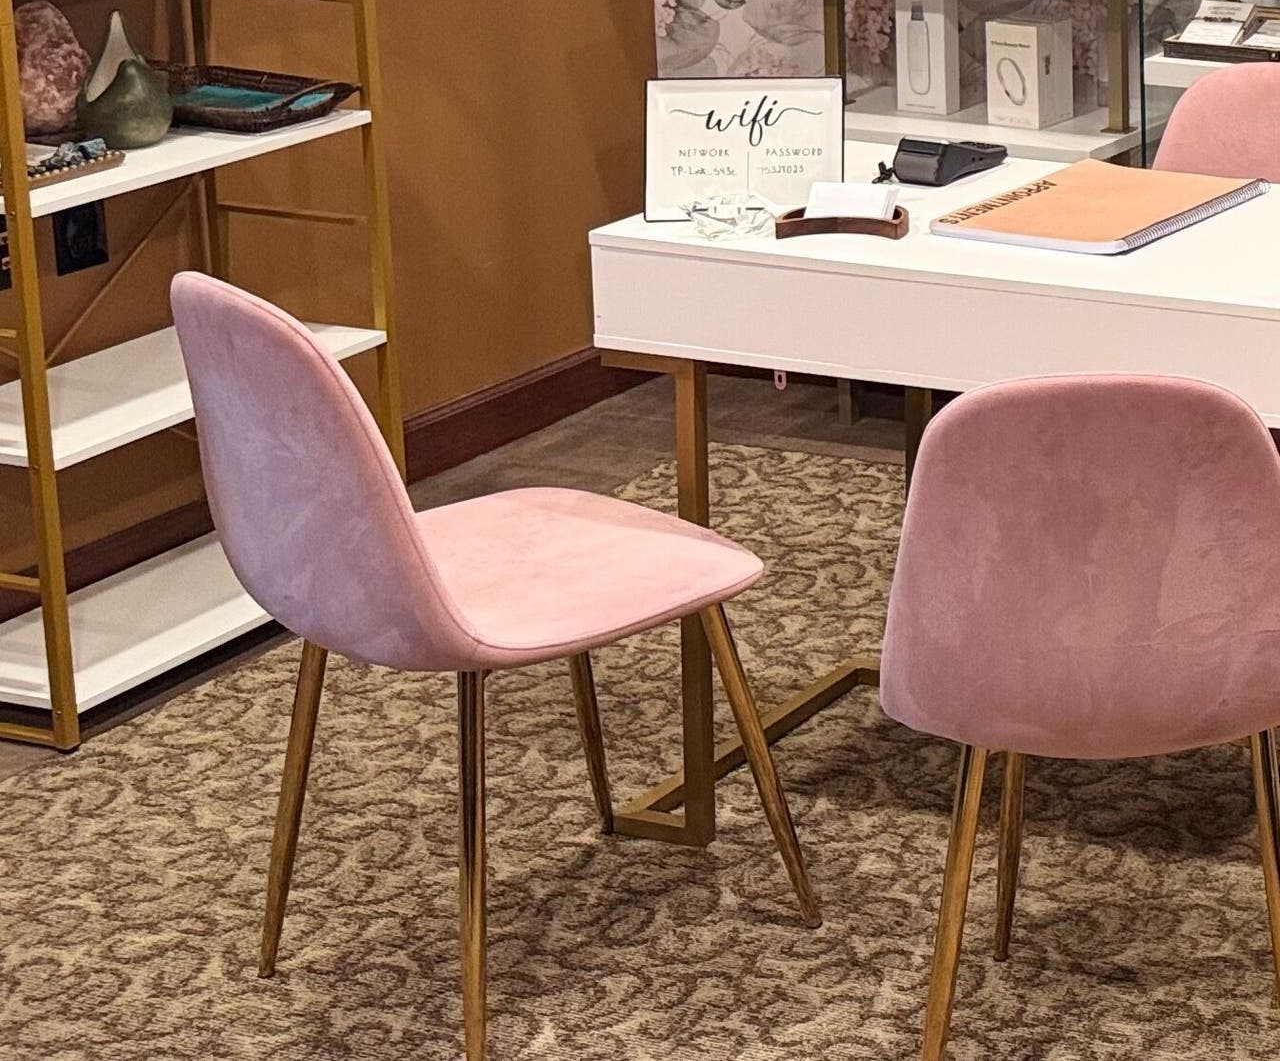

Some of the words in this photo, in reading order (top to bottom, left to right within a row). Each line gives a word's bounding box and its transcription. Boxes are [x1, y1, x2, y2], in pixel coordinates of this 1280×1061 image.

[678, 148, 730, 157] NETWORK
[765, 147, 823, 157] PASSWORD
[938, 179, 1058, 225] APPOINTMENTS
